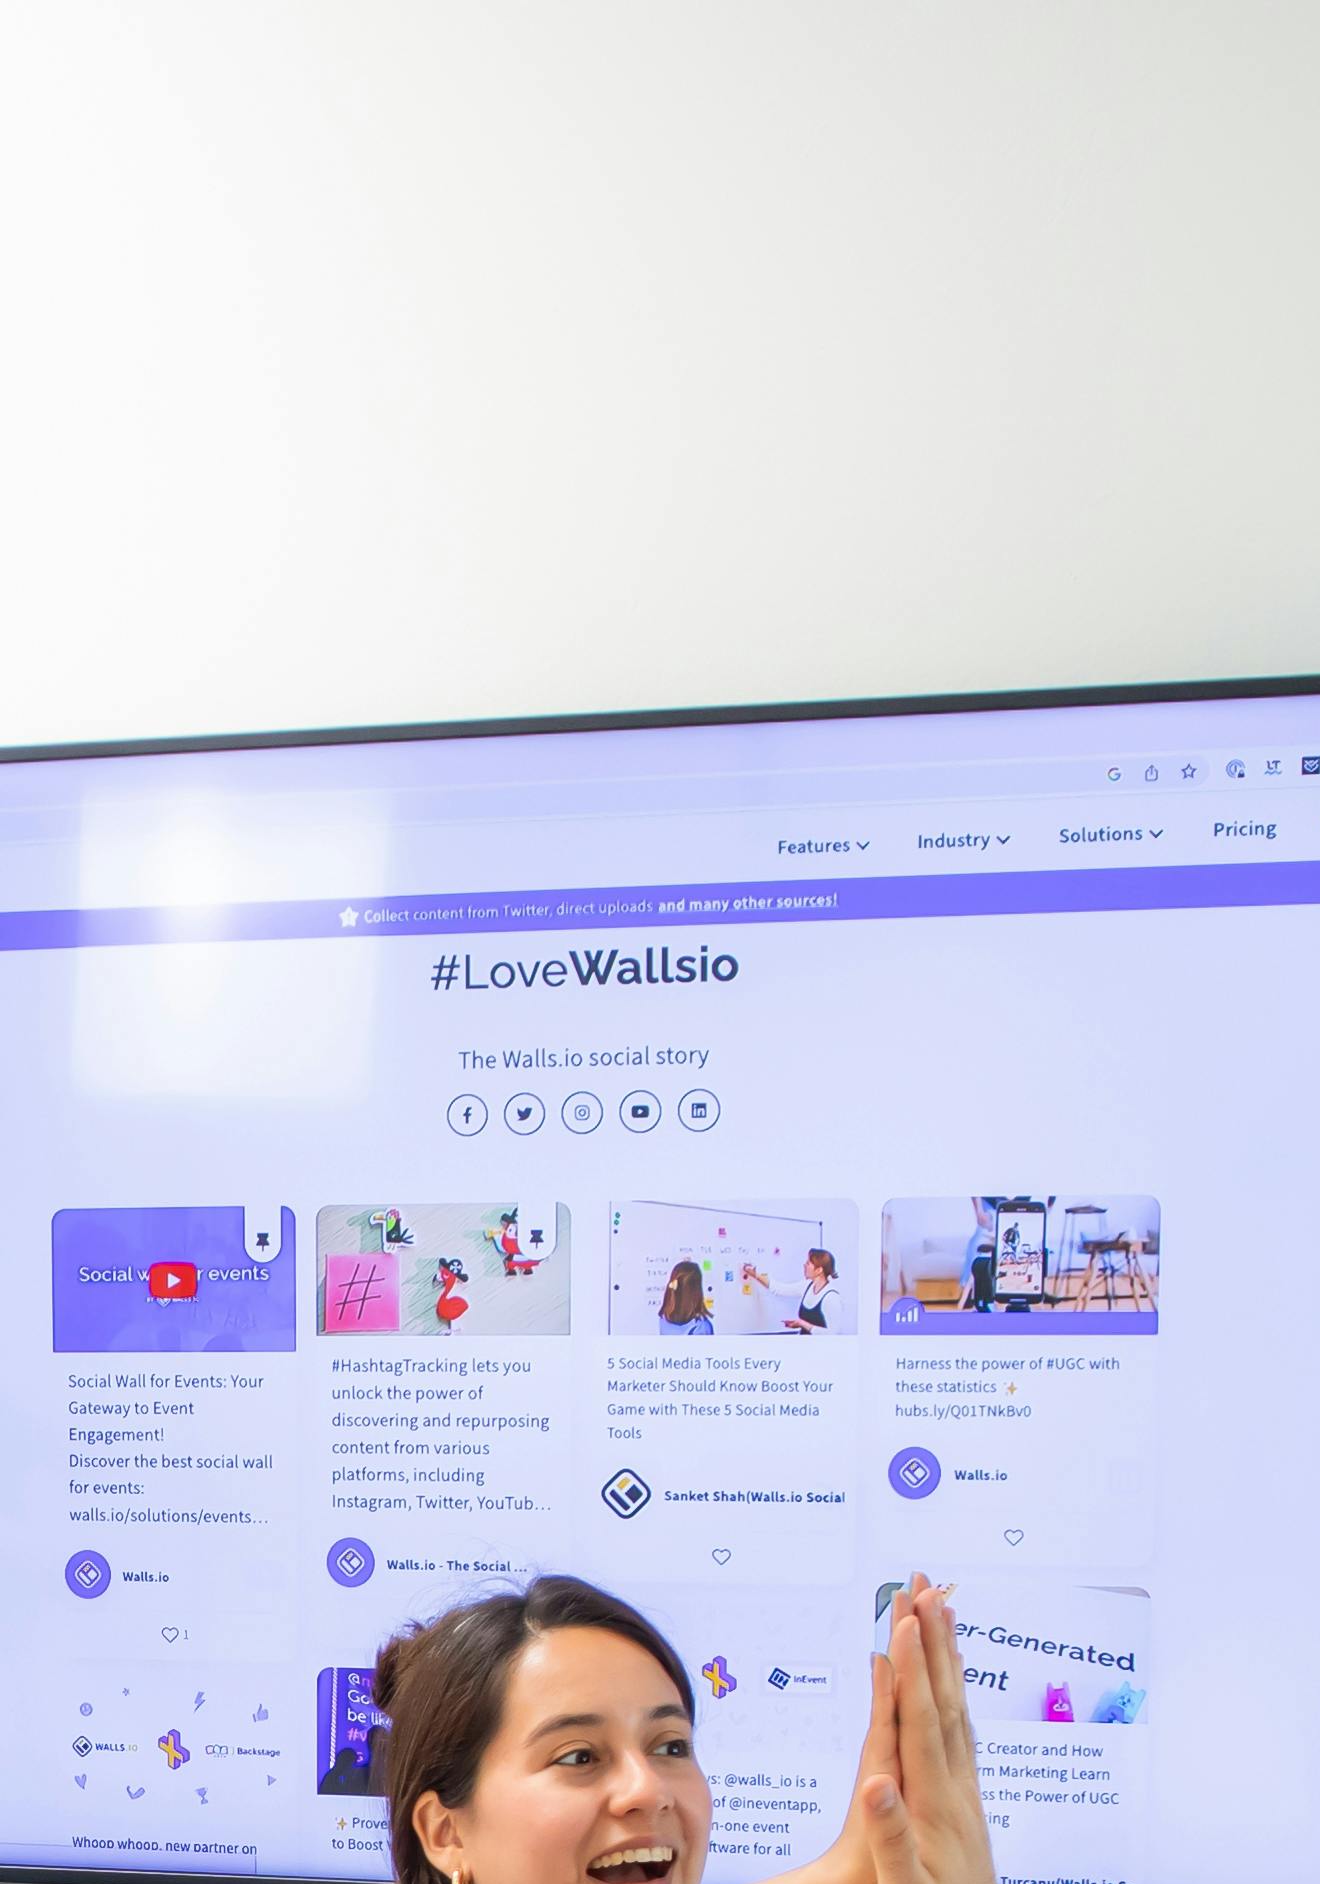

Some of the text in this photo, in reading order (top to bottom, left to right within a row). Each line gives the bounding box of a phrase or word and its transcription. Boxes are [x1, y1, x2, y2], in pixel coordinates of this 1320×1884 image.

[778, 838, 850, 854] Features
[918, 833, 990, 850] Industry
[1059, 827, 1142, 843] Solutions
[1213, 820, 1278, 839] Pricing
[364, 893, 838, 924] Collect content from Twitter, direct uploads and many other sources!
[430, 945, 740, 991] #LoveWallsio
[458, 1046, 710, 1070] The Walls.io social story
[79, 1266, 132, 1282] Social
[208, 1266, 269, 1281] events
[332, 1358, 531, 1377] #HashtagTracking lets you
[607, 1357, 780, 1373] 5 Social Media Tools Every
[896, 1357, 1120, 1374] Harness the power of #UGC with
[68, 1374, 263, 1388] Social Wall for Events: Your
[608, 1380, 834, 1393] Marketer Should Know Boost Your
[895, 1380, 997, 1394] these statistics
[332, 1386, 483, 1403] unlock the power of
[68, 1402, 194, 1418] Gateway to Event
[607, 1403, 819, 1417] Game with These 5 Social Media
[332, 1413, 550, 1432] discovering and repurposing
[69, 1428, 164, 1445] Engagement!
[607, 1427, 642, 1439] Tools
[332, 1440, 490, 1455] content from various
[69, 1454, 273, 1469] Discover the best social wall
[332, 1467, 485, 1486] platforms, including
[954, 1469, 1008, 1481] Walls.io
[69, 1480, 144, 1495] for events:
[332, 1495, 412, 1512] Instagram,
[416, 1496, 473, 1511] Twitter,
[664, 1491, 845, 1504] Sanket Shah(Walls.io Social
[387, 1559, 435, 1571] Walls.io
[447, 1560, 470, 1572] The
[473, 1560, 510, 1572] Social
[122, 1571, 169, 1584] Walls.io
[956, 1622, 1136, 1672] er-Generated
[348, 1708, 366, 1723] be
[237, 1747, 280, 1757] Backstage
[988, 1742, 1038, 1756] Creator
[1042, 1744, 1067, 1756] and
[1072, 1745, 1103, 1757] How
[724, 1774, 792, 1788] @walls_io
[796, 1775, 806, 1787] is
[810, 1778, 817, 1788] a
[1000, 1766, 1068, 1782] Marketing
[1072, 1768, 1110, 1780] Learn
[999, 1789, 1021, 1801] the
[1026, 1790, 1069, 1802] Power
[1072, 1791, 1087, 1803] of
[1090, 1792, 1119, 1804] UGC
[713, 1796, 821, 1814] of @ineventapp,
[353, 1817, 387, 1829] Prove
[712, 1822, 790, 1833] n-one event
[166, 1842, 190, 1851] new
[242, 1845, 257, 1855] on
[332, 1839, 344, 1849] to
[348, 1839, 383, 1851] Boost
[709, 1841, 791, 1856] ftware for all
